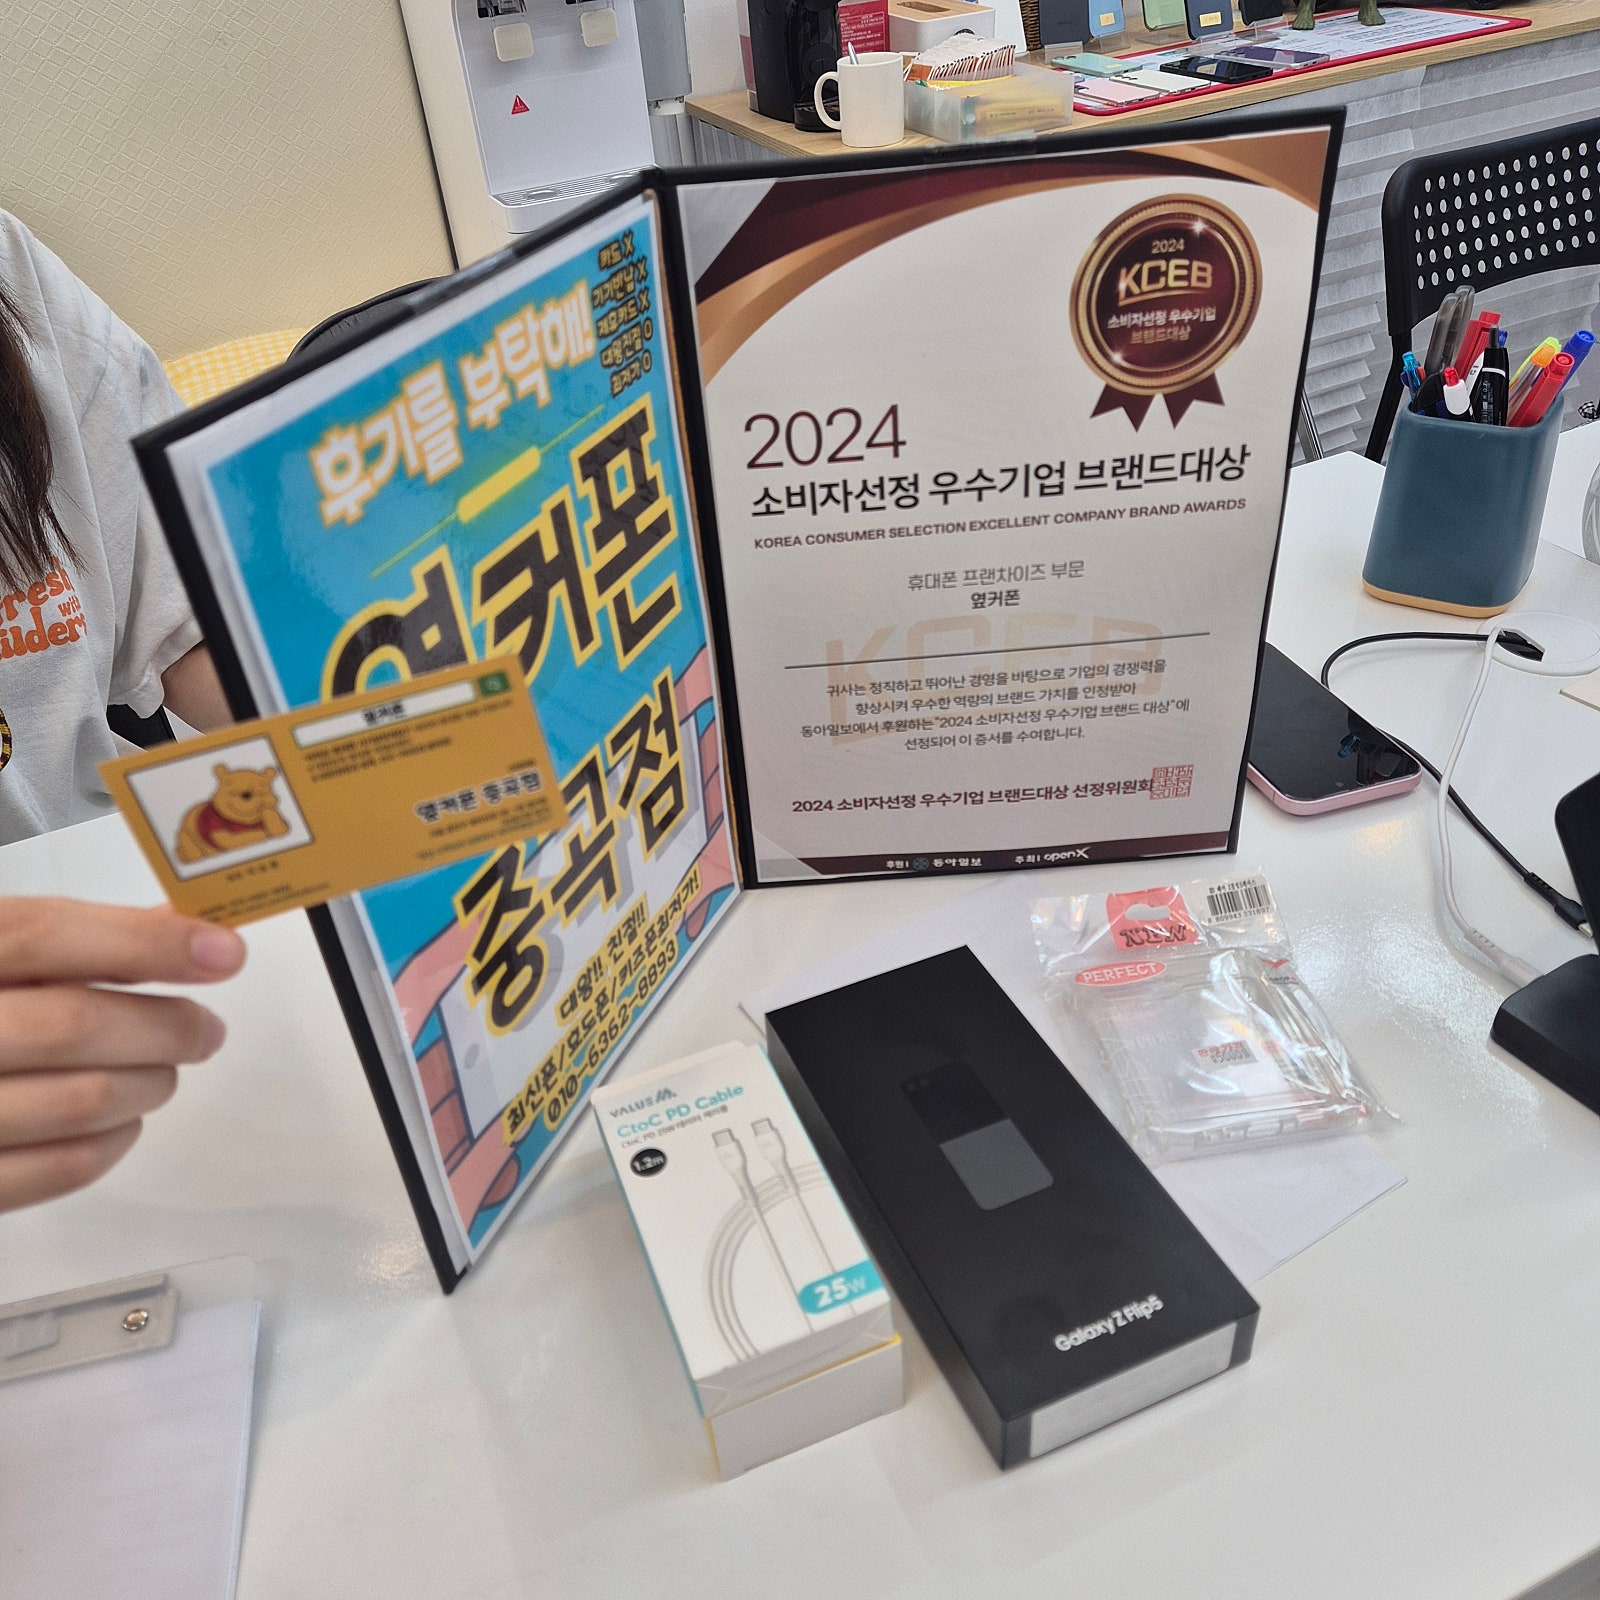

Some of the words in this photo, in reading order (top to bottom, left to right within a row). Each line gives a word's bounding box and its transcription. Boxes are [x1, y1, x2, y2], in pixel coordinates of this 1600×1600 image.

[1151, 238, 1185, 254] 2024
[592, 262, 635, 310] 기기반납
[1118, 258, 1213, 307] KCEB
[1107, 309, 1167, 329] 소비자선정
[1168, 305, 1217, 323] 우수기업
[1130, 325, 1192, 344] 브랜드대상
[309, 358, 465, 528] 후기를
[458, 279, 597, 431] 부탁해!
[744, 404, 907, 469] 2024
[751, 472, 921, 518] 소비자선정
[928, 460, 1066, 505] 우수기업
[1074, 443, 1252, 491] 브랜드대상
[754, 535, 802, 550] KOREA
[805, 528, 886, 546] CONSUMER
[889, 521, 966, 539] SELECTION
[968, 514, 1051, 533] EXCELLENT
[1053, 507, 1127, 525] COMPANY
[1129, 503, 1181, 518] BRAND
[1182, 498, 1247, 514] AWARDS
[908, 570, 958, 591] 휴대폰
[962, 563, 1047, 587] 프랜차이즈
[1050, 560, 1085, 579] 부문
[970, 588, 1021, 610] 옆커폰
[826, 684, 867, 698] 귀사는
[868, 679, 923, 695] 정직하고
[925, 674, 966, 690] 뛰어난
[968, 671, 1008, 688] 경영을
[1011, 667, 1066, 683] 바탕으로
[1068, 663, 1110, 679] 기업의
[1112, 658, 1167, 676] 경쟁력을
[855, 700, 909, 716] 향상시켜
[911, 695, 951, 711] 우수한
[953, 693, 993, 709] 역량의
[995, 689, 1037, 705] 브랜드
[1038, 686, 1080, 701] 가치를
[1082, 682, 1136, 700] 인정받아
[801, 721, 879, 738] 동아일보에서
[975, 709, 1041, 726] 소비자선정
[1044, 705, 1098, 722] 우수기업
[1101, 702, 1141, 717] 브랜드
[904, 735, 957, 750] 선정되어
[958, 733, 972, 746] 이
[974, 730, 1013, 747] 증서를
[1016, 726, 1085, 743] 수여합니다.
[792, 799, 833, 812] 2024
[836, 794, 917, 811] 소비자선정
[920, 790, 984, 807] 우수기업
[987, 784, 1069, 803] 브랜드대상
[1072, 778, 1154, 799] 선정위원회
[453, 665, 687, 1038] 중곡점
[932, 857, 983, 868] 동아일보
[1120, 923, 1187, 948] NEW
[560, 954, 605, 1021] 대왕!!
[607, 901, 646, 965] 친절!!
[1082, 962, 1157, 983] PERFECT
[547, 939, 677, 1123] 010-6362-8893
[617, 1112, 662, 1138] CtoC
[665, 1102, 691, 1121] PD
[694, 1085, 744, 1110] Cable
[633, 1155, 665, 1172] 1.2m
[1054, 1317, 1116, 1351] Galaxy
[1111, 1309, 1128, 1327] Z
[1122, 1294, 1164, 1322] Flip5
